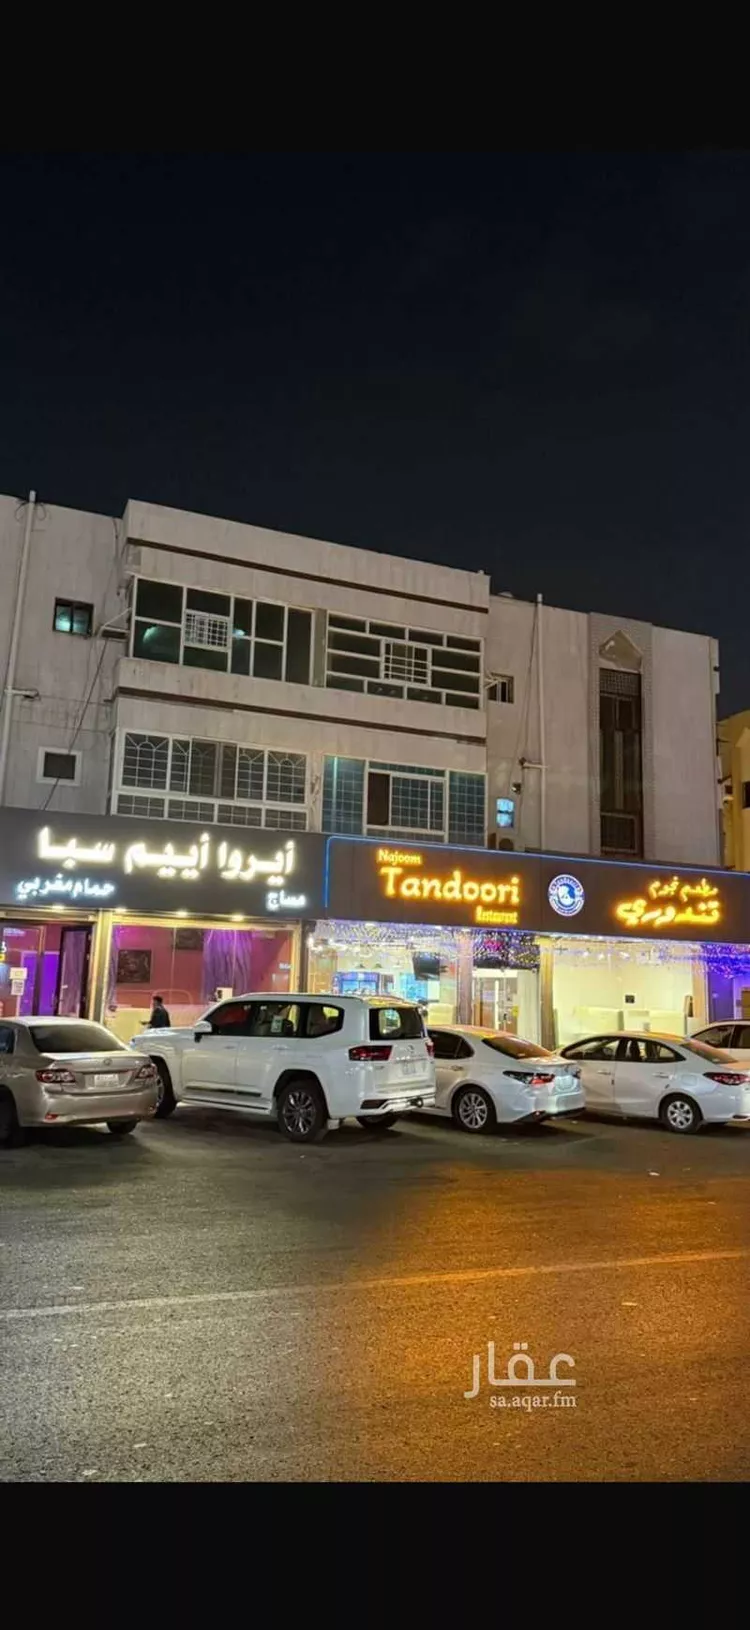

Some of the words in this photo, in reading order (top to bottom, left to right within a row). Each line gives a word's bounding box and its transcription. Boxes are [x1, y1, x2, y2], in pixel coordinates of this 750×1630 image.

[37, 826, 116, 869] سبا
[377, 848, 422, 866] Najoom
[217, 840, 296, 886] أيروا
[16, 873, 73, 900] مغربي
[72, 877, 116, 899] حمام
[379, 866, 520, 905] Tandoori
[648, 875, 679, 899] نجوم
[680, 877, 719, 902] مطعم
[266, 889, 307, 912] مساج
[616, 898, 721, 927] تندوري
